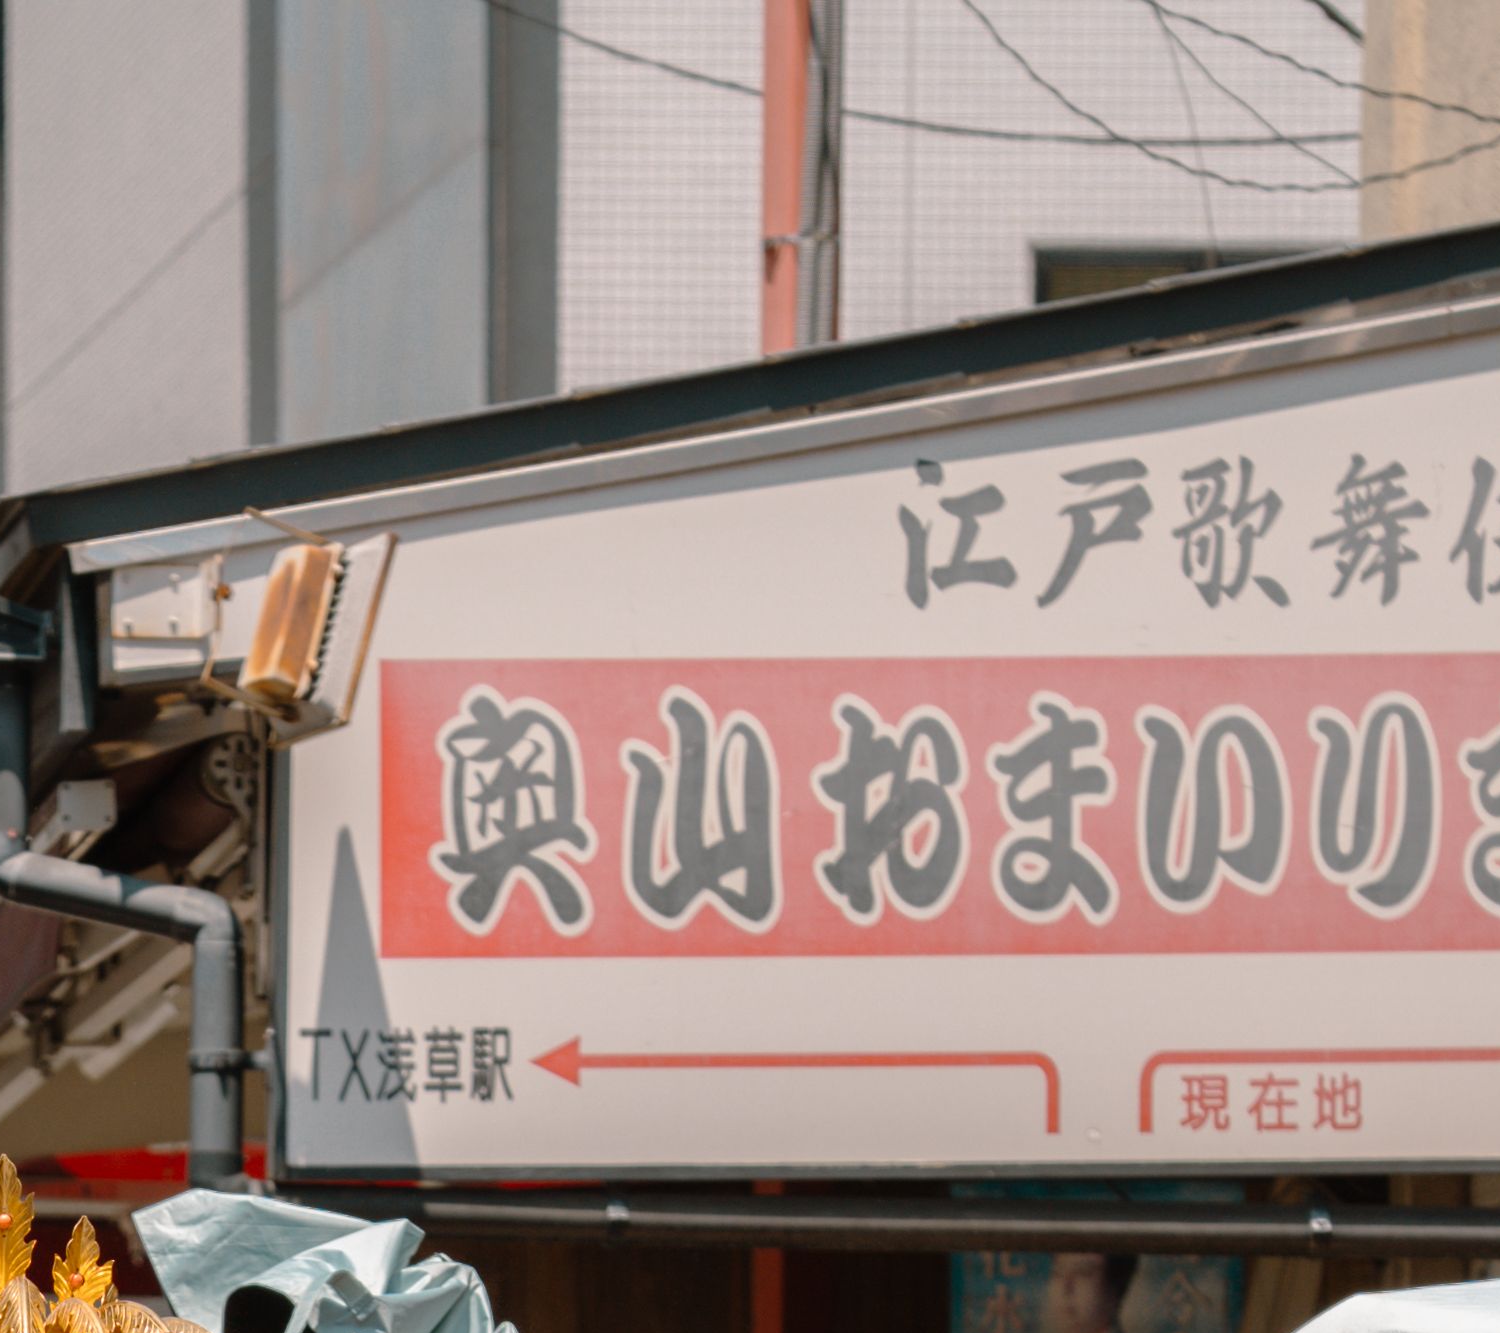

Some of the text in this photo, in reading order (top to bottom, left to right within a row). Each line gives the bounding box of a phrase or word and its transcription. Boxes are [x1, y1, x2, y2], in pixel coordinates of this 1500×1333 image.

[298, 1024, 515, 1106] TX浅草駅
[1179, 1073, 1365, 1134] 現在地
